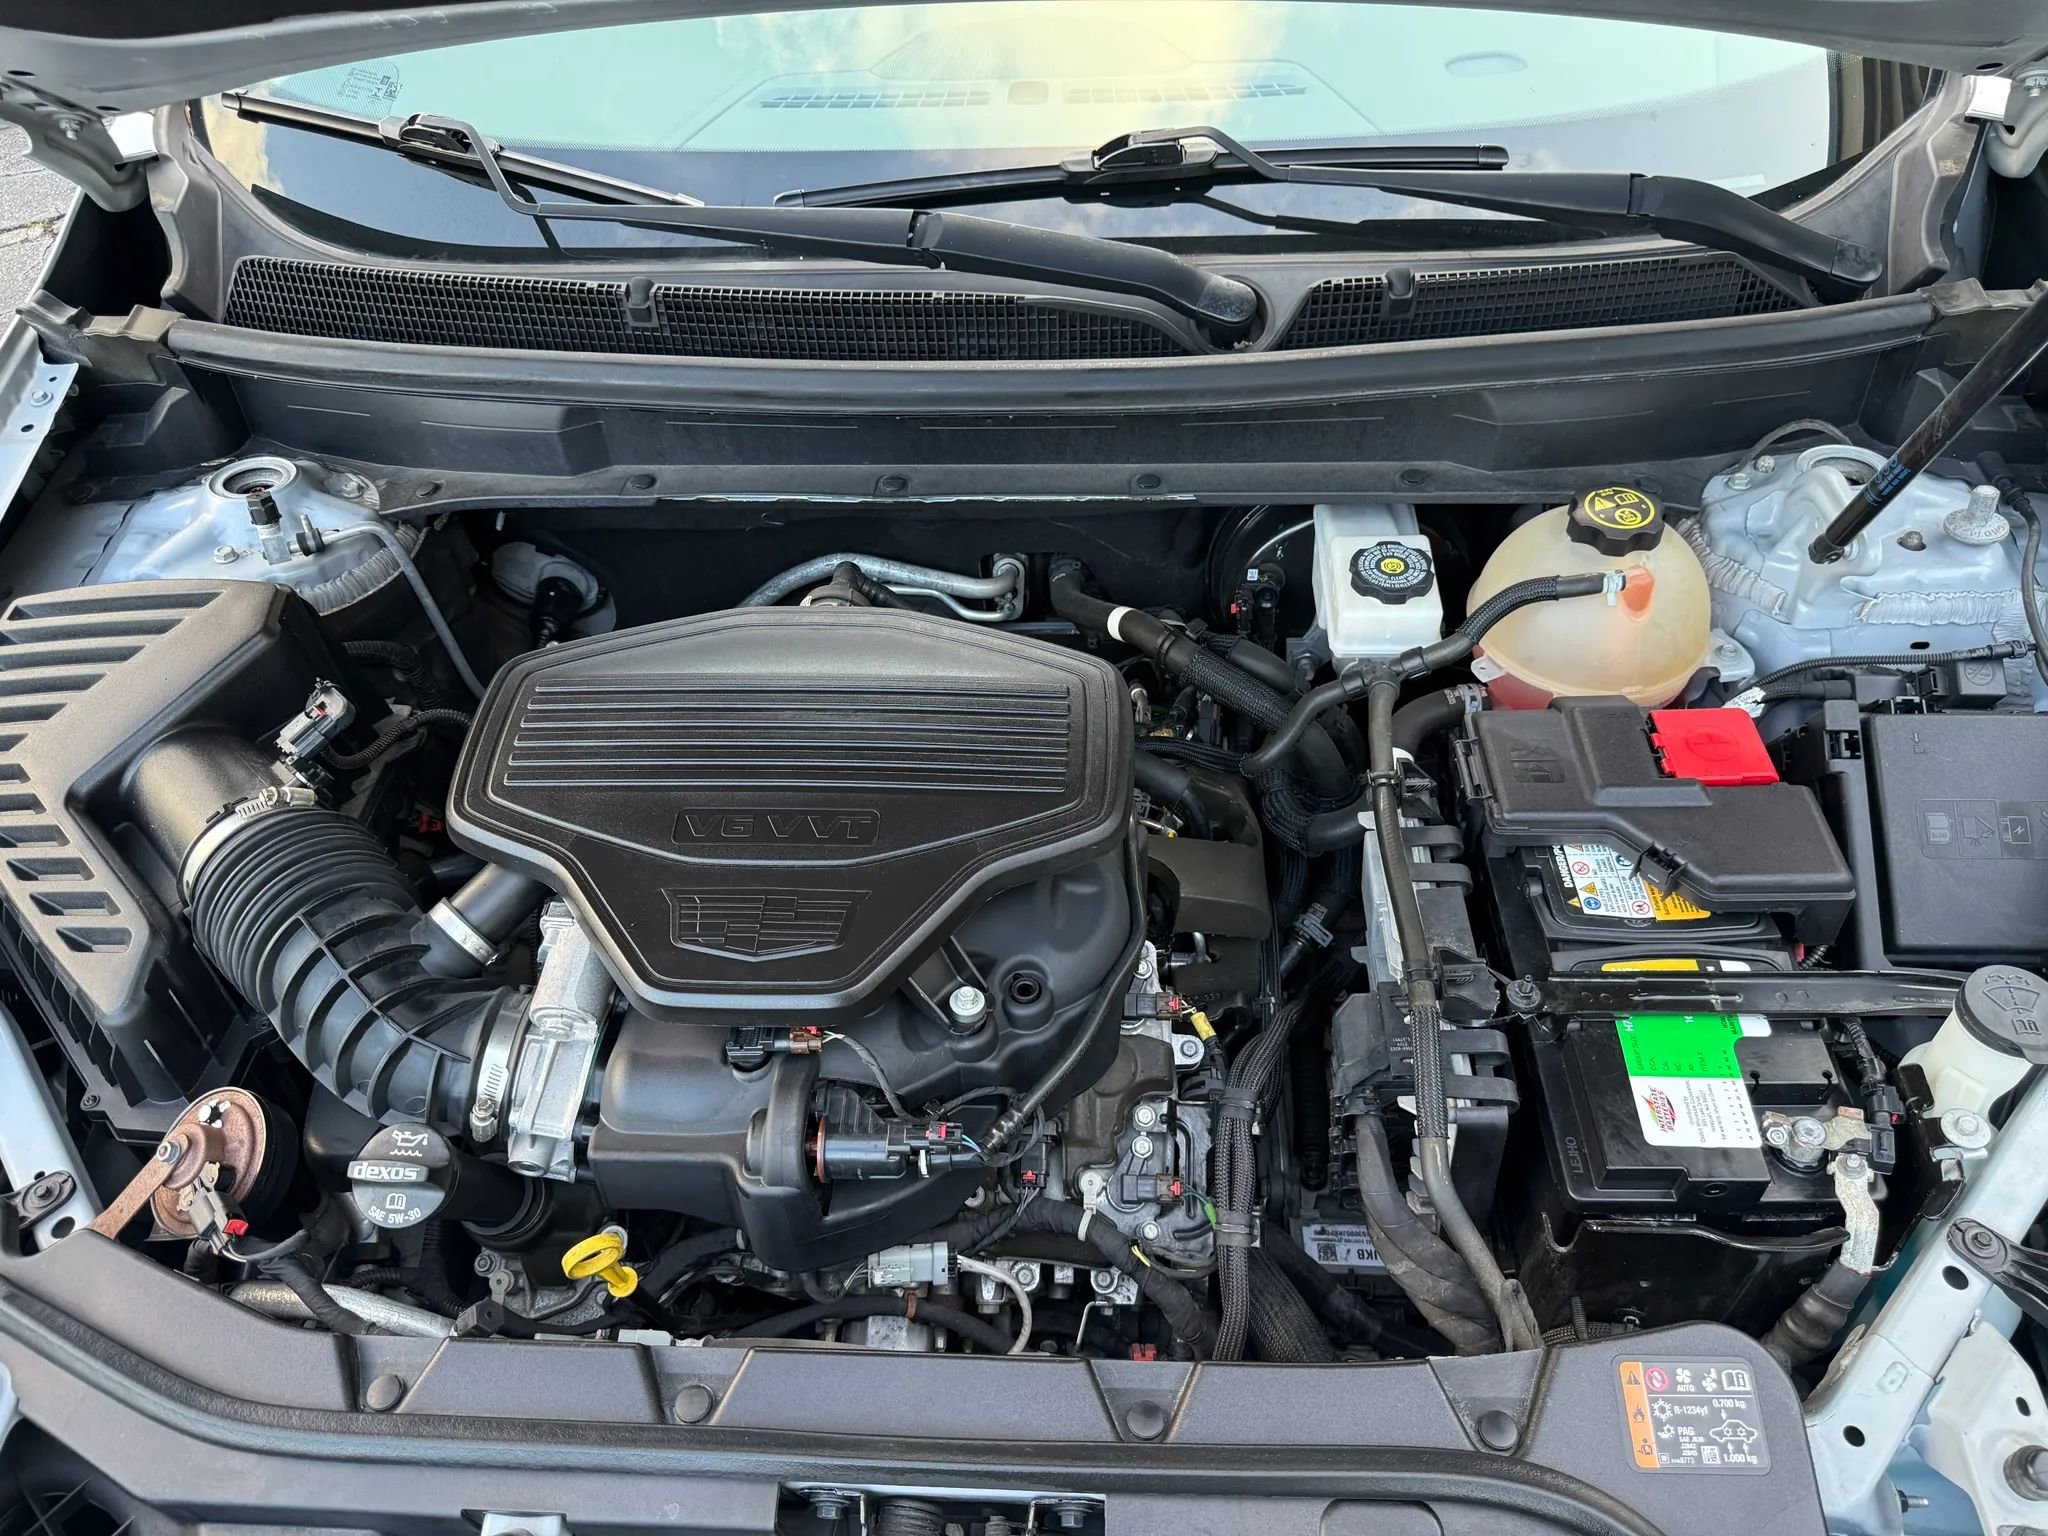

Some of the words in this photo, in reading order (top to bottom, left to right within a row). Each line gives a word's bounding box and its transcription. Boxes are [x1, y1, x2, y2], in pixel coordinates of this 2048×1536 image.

[685, 815, 754, 837] V6
[767, 815, 872, 839] VVT
[1648, 1087, 1666, 1131] INTERSTATE
[353, 1162, 418, 1180] dexos
[368, 1205, 386, 1221] SAE
[388, 1207, 421, 1224] 5W-30
[1713, 1399, 1734, 1408] 0.700
[1735, 1399, 1746, 1409] kg
[1678, 1427, 1695, 1435] PAG
[1723, 1454, 1746, 1463] 1.000
[1746, 1454, 1758, 1464] kg
